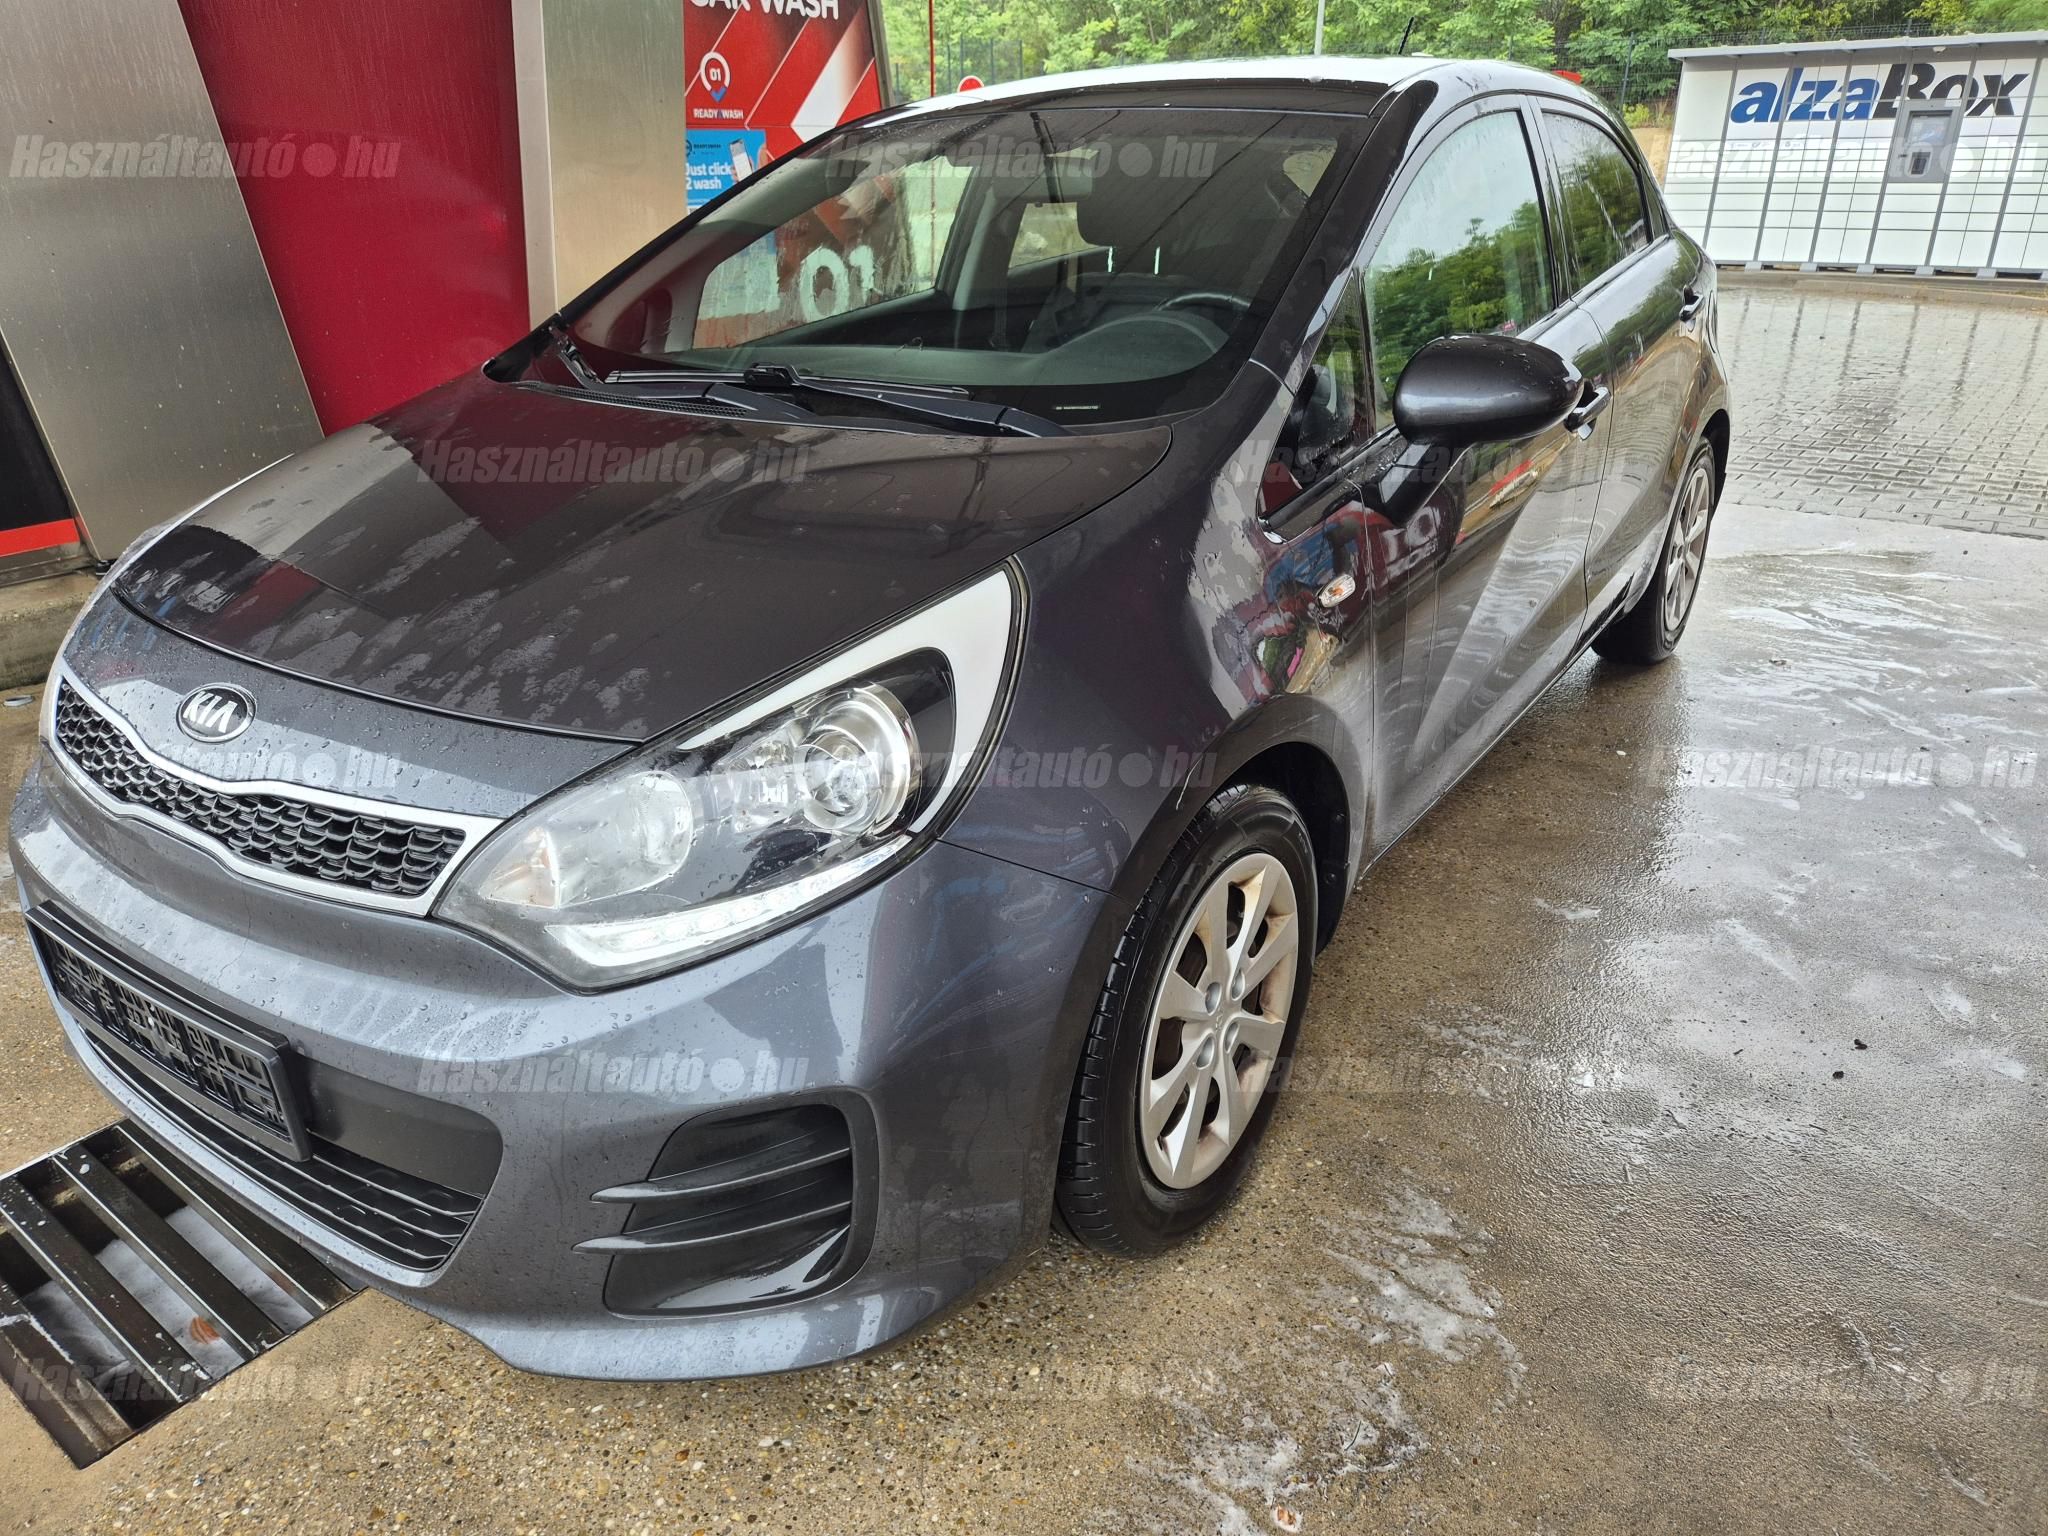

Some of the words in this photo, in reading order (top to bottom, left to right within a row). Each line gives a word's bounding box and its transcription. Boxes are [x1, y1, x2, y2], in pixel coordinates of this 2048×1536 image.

[1730, 63, 2030, 124] alzaBox
[693, 176, 722, 191] wash
[182, 690, 239, 734] KIA
